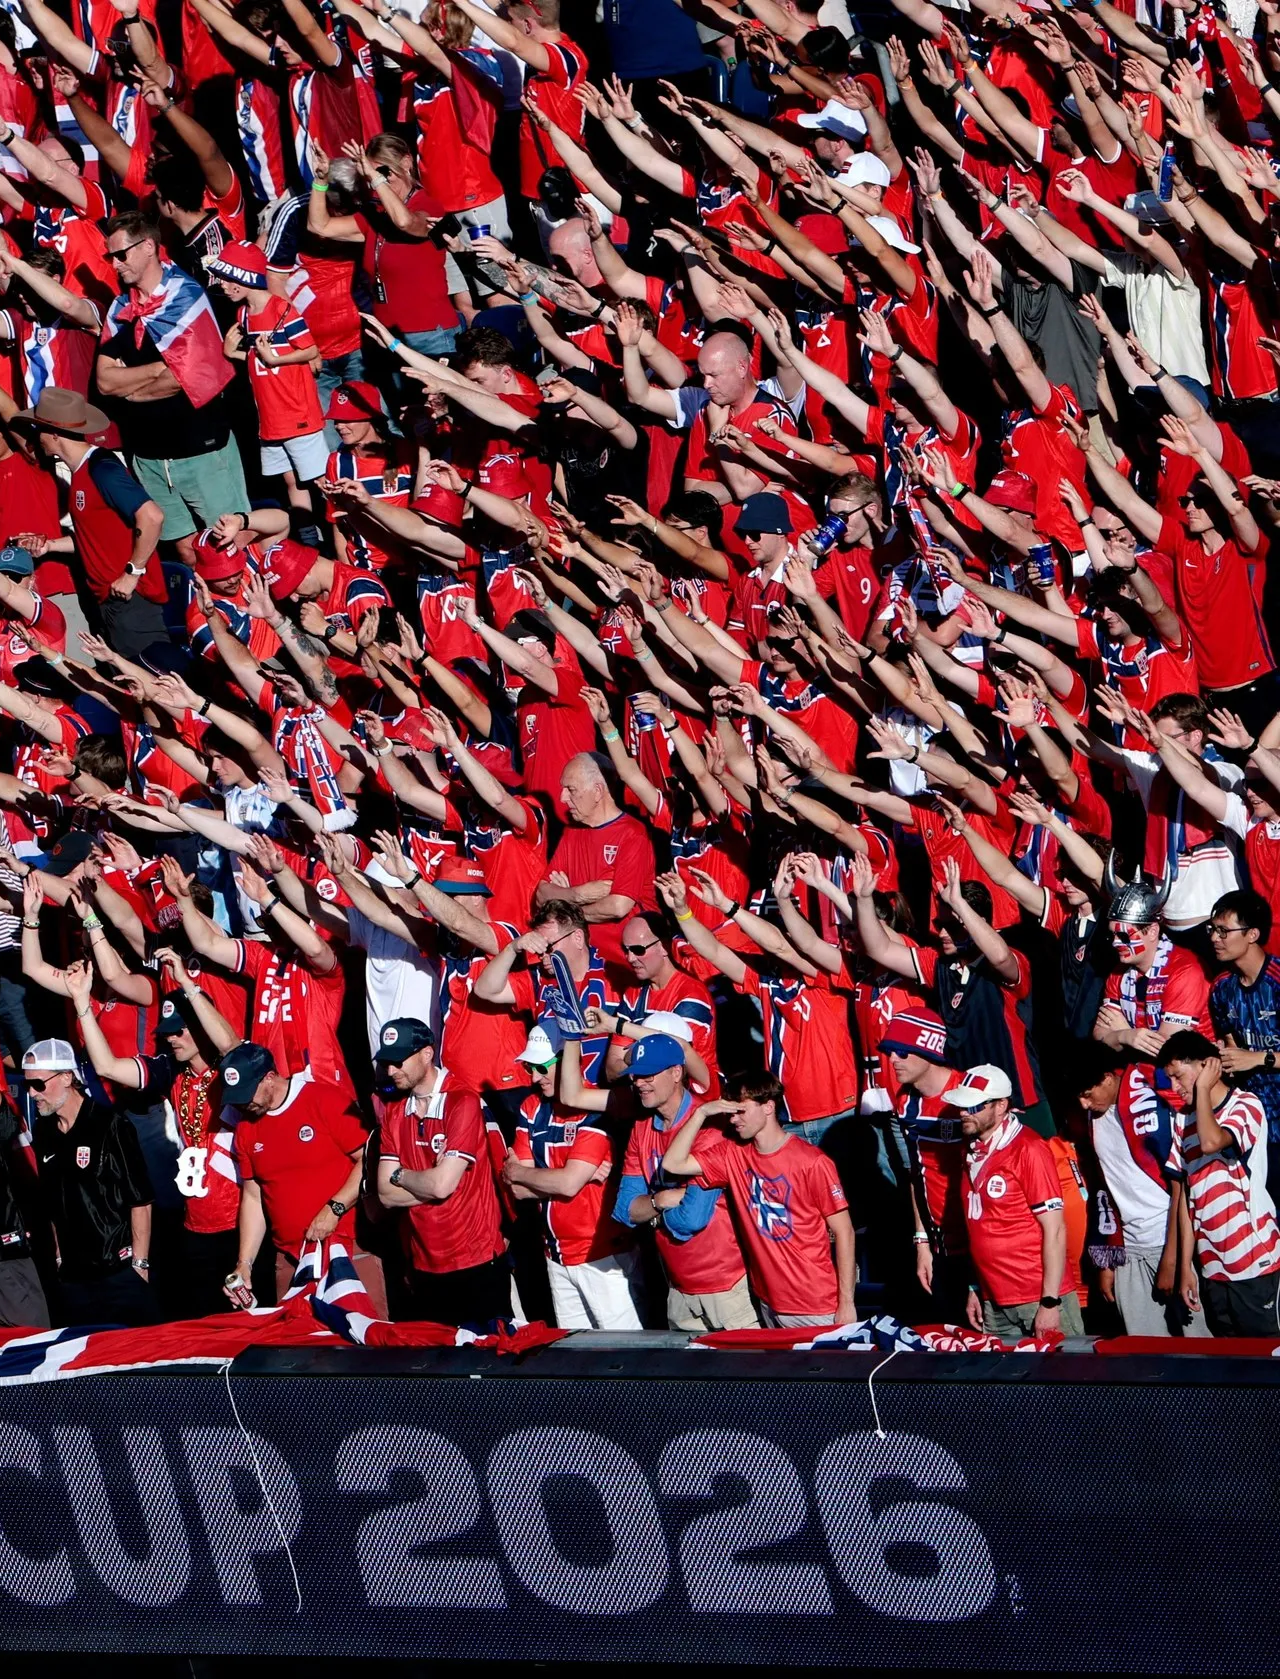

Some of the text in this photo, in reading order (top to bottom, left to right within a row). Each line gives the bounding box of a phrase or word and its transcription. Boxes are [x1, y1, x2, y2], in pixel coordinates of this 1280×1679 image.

[860, 577, 871, 605] 9
[1164, 1011, 1190, 1026] NORGE
[915, 1028, 947, 1055] 202
[967, 1190, 983, 1221] 10
[334, 1424, 997, 1622] 2026
